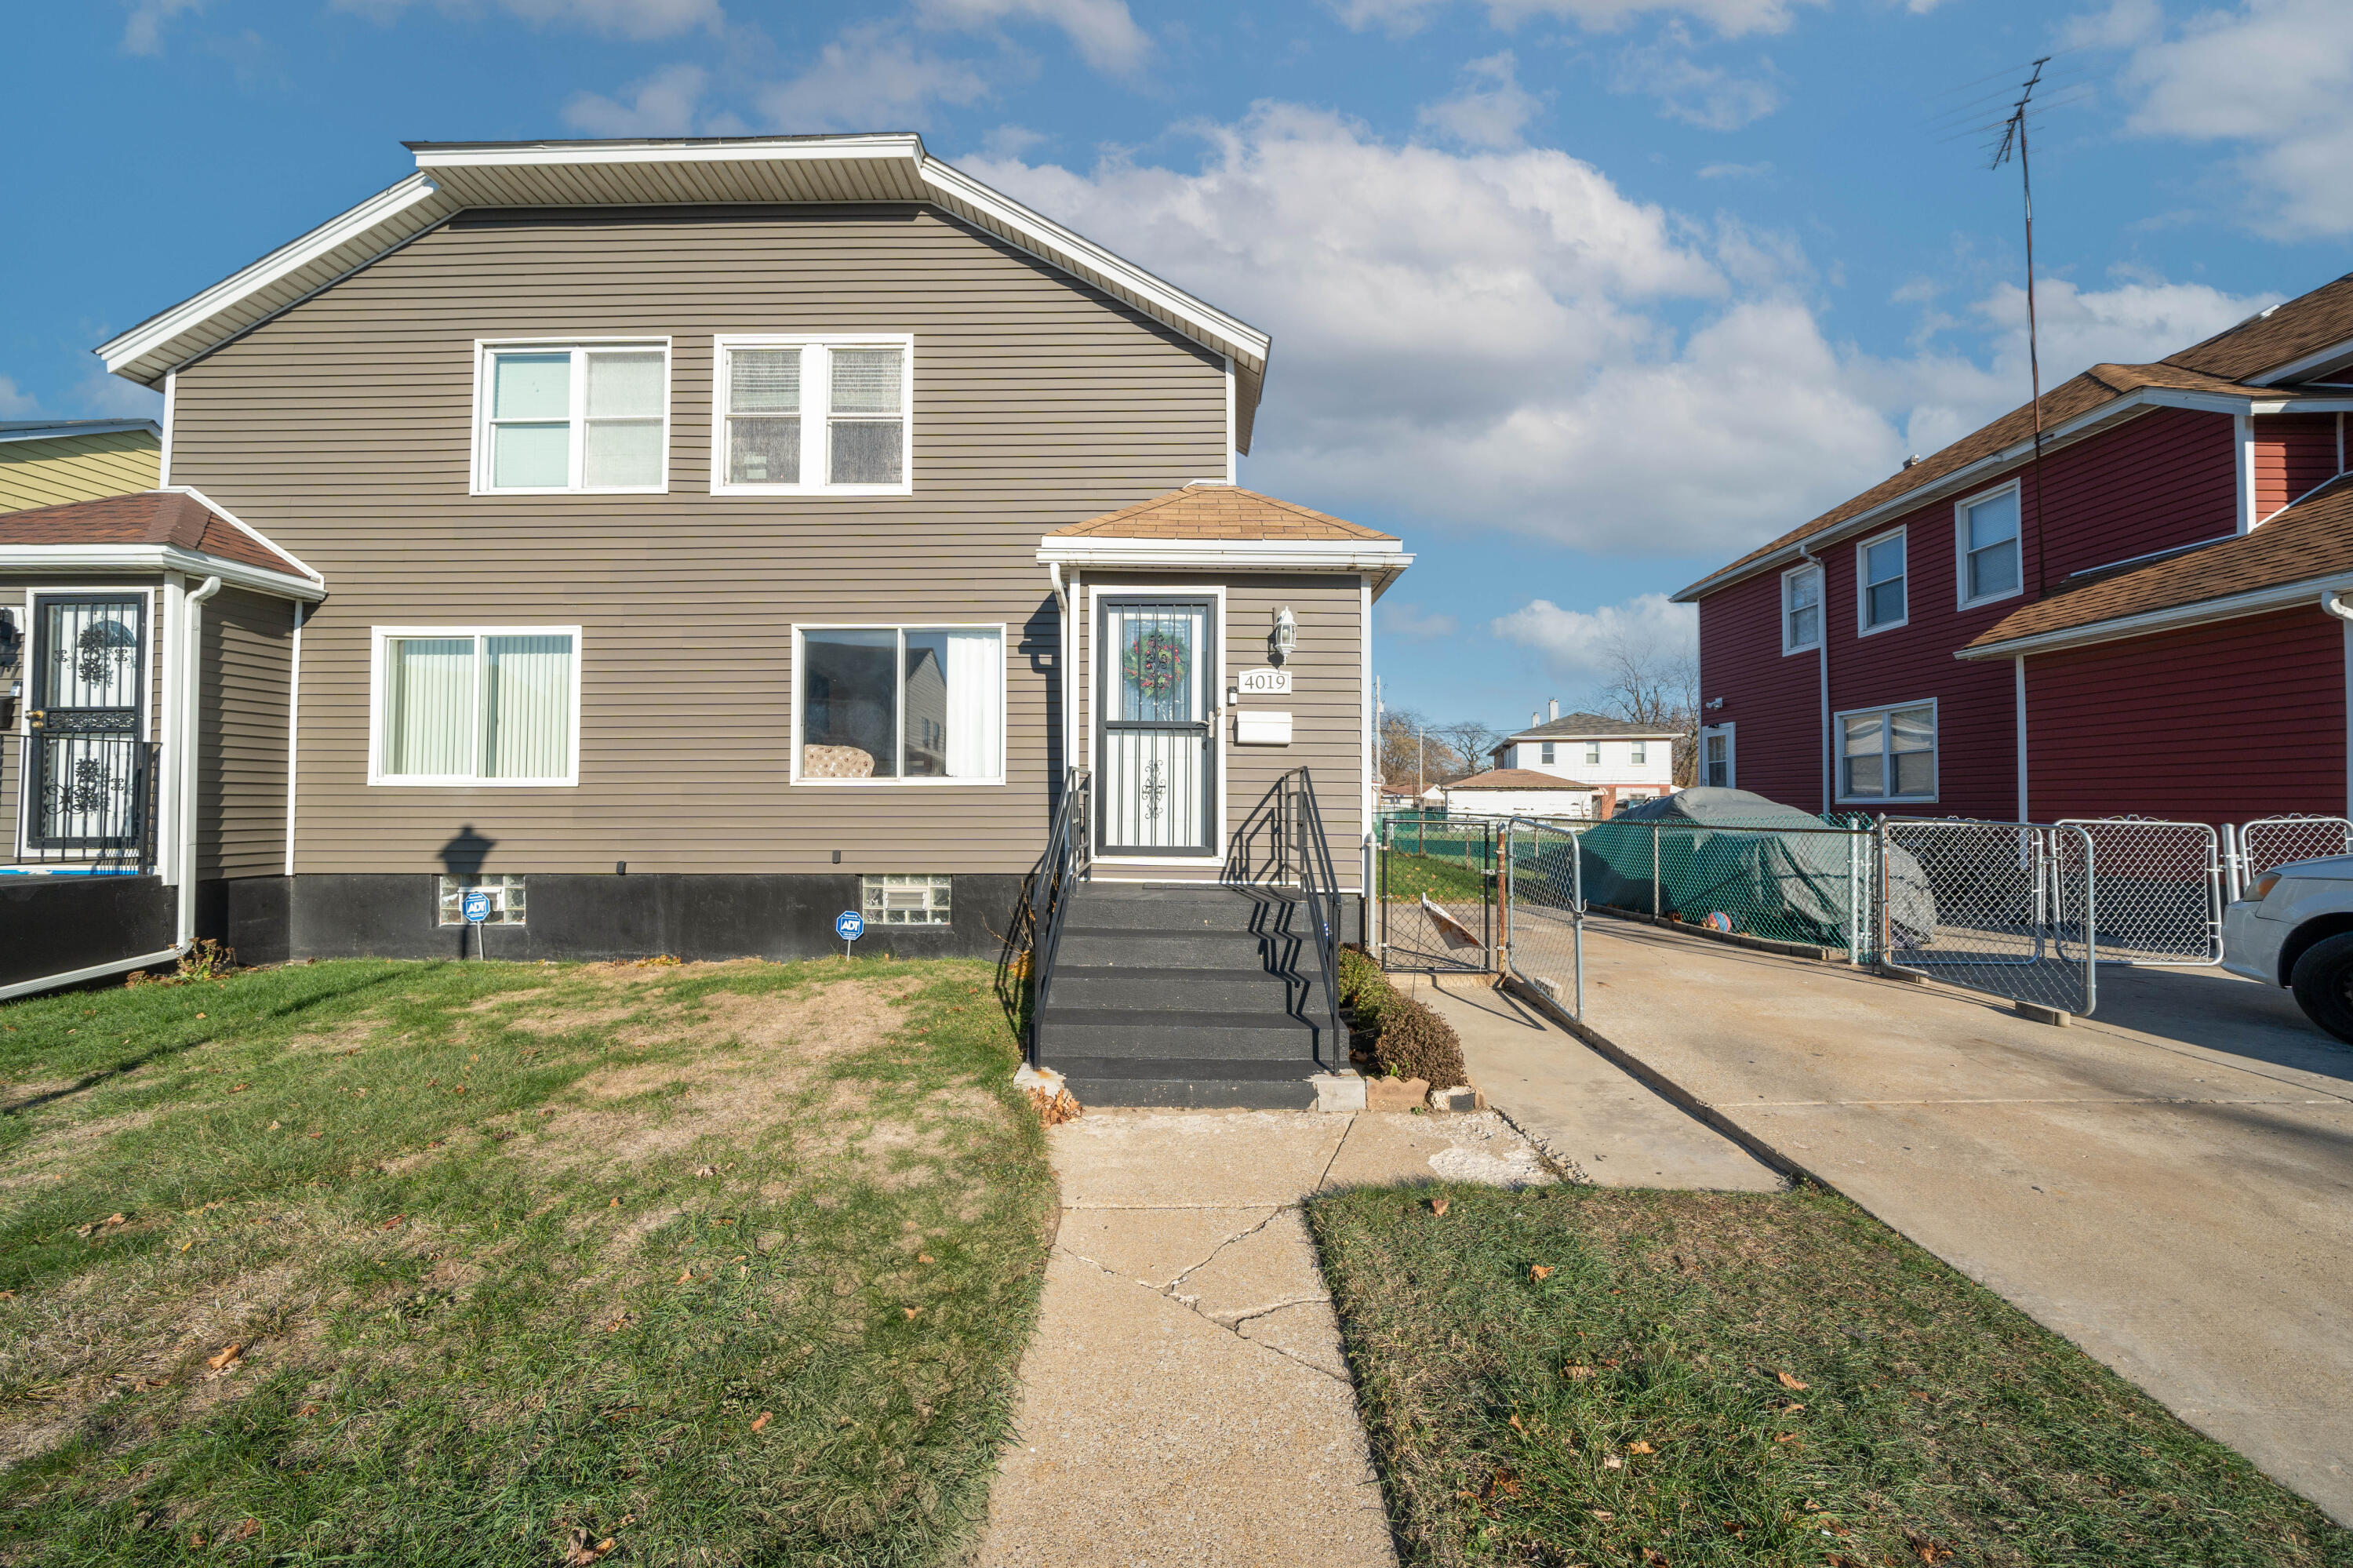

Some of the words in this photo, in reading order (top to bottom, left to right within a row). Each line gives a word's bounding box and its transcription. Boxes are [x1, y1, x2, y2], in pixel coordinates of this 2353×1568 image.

[1244, 675, 1286, 689] 4019
[467, 901, 486, 913] ADT
[841, 919, 860, 931] ADT
